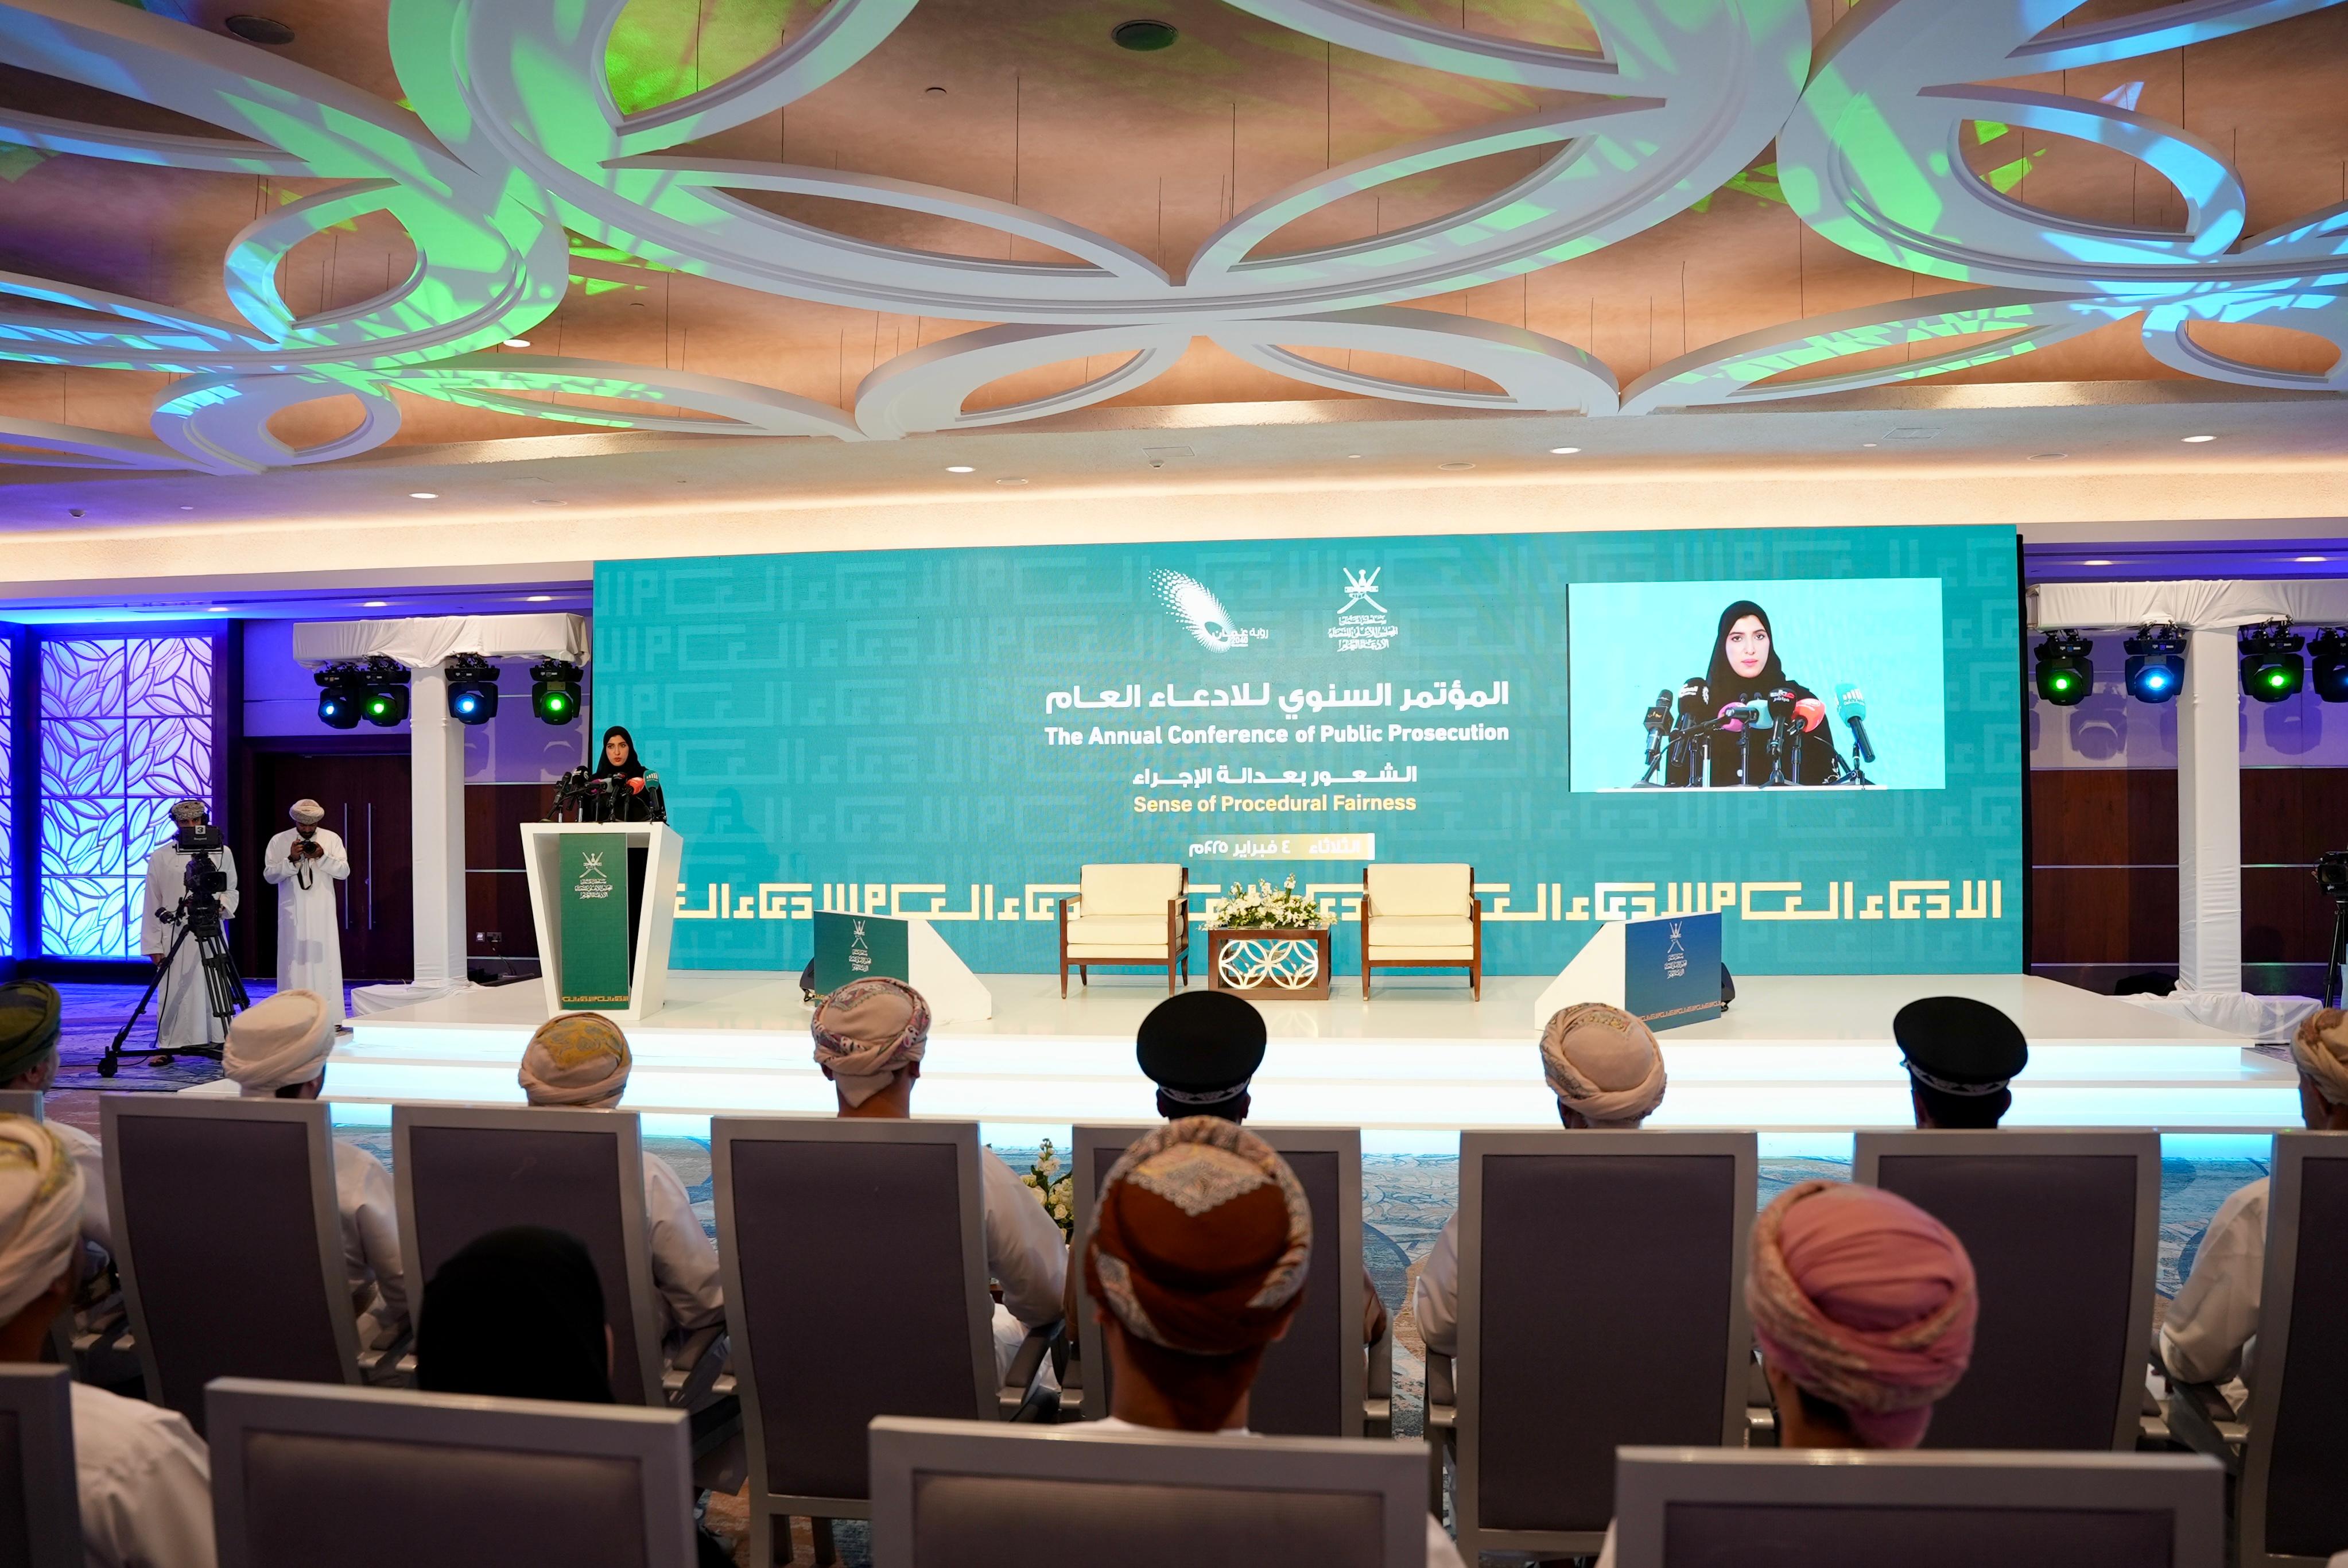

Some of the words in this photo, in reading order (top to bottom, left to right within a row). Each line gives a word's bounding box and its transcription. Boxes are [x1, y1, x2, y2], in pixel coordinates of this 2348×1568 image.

[1231, 636, 1249, 644] 2040
[1046, 684, 1141, 715] العام
[1149, 682, 1270, 708] للادعاء
[1278, 682, 1392, 720] السنوي
[1400, 680, 1509, 712] المؤتمر
[1045, 727, 1083, 745] The
[1088, 726, 1162, 744] Annual
[1168, 725, 1289, 744] Conference
[1295, 725, 1316, 743] of
[1321, 724, 1383, 742] Public
[1388, 723, 1509, 742] Prosecution
[1132, 767, 1213, 789] الإجراء
[1216, 764, 1306, 787] بعدالة
[1311, 762, 1418, 787] الشعور
[1134, 797, 1192, 813] Sense
[1197, 795, 1216, 812] of
[1221, 794, 1328, 812] Procedural
[1333, 794, 1417, 811] Fairness
[1232, 840, 1278, 858] فبراير
[1282, 840, 1291, 854] ٤
[1308, 836, 1361, 854] الثلاثاء
